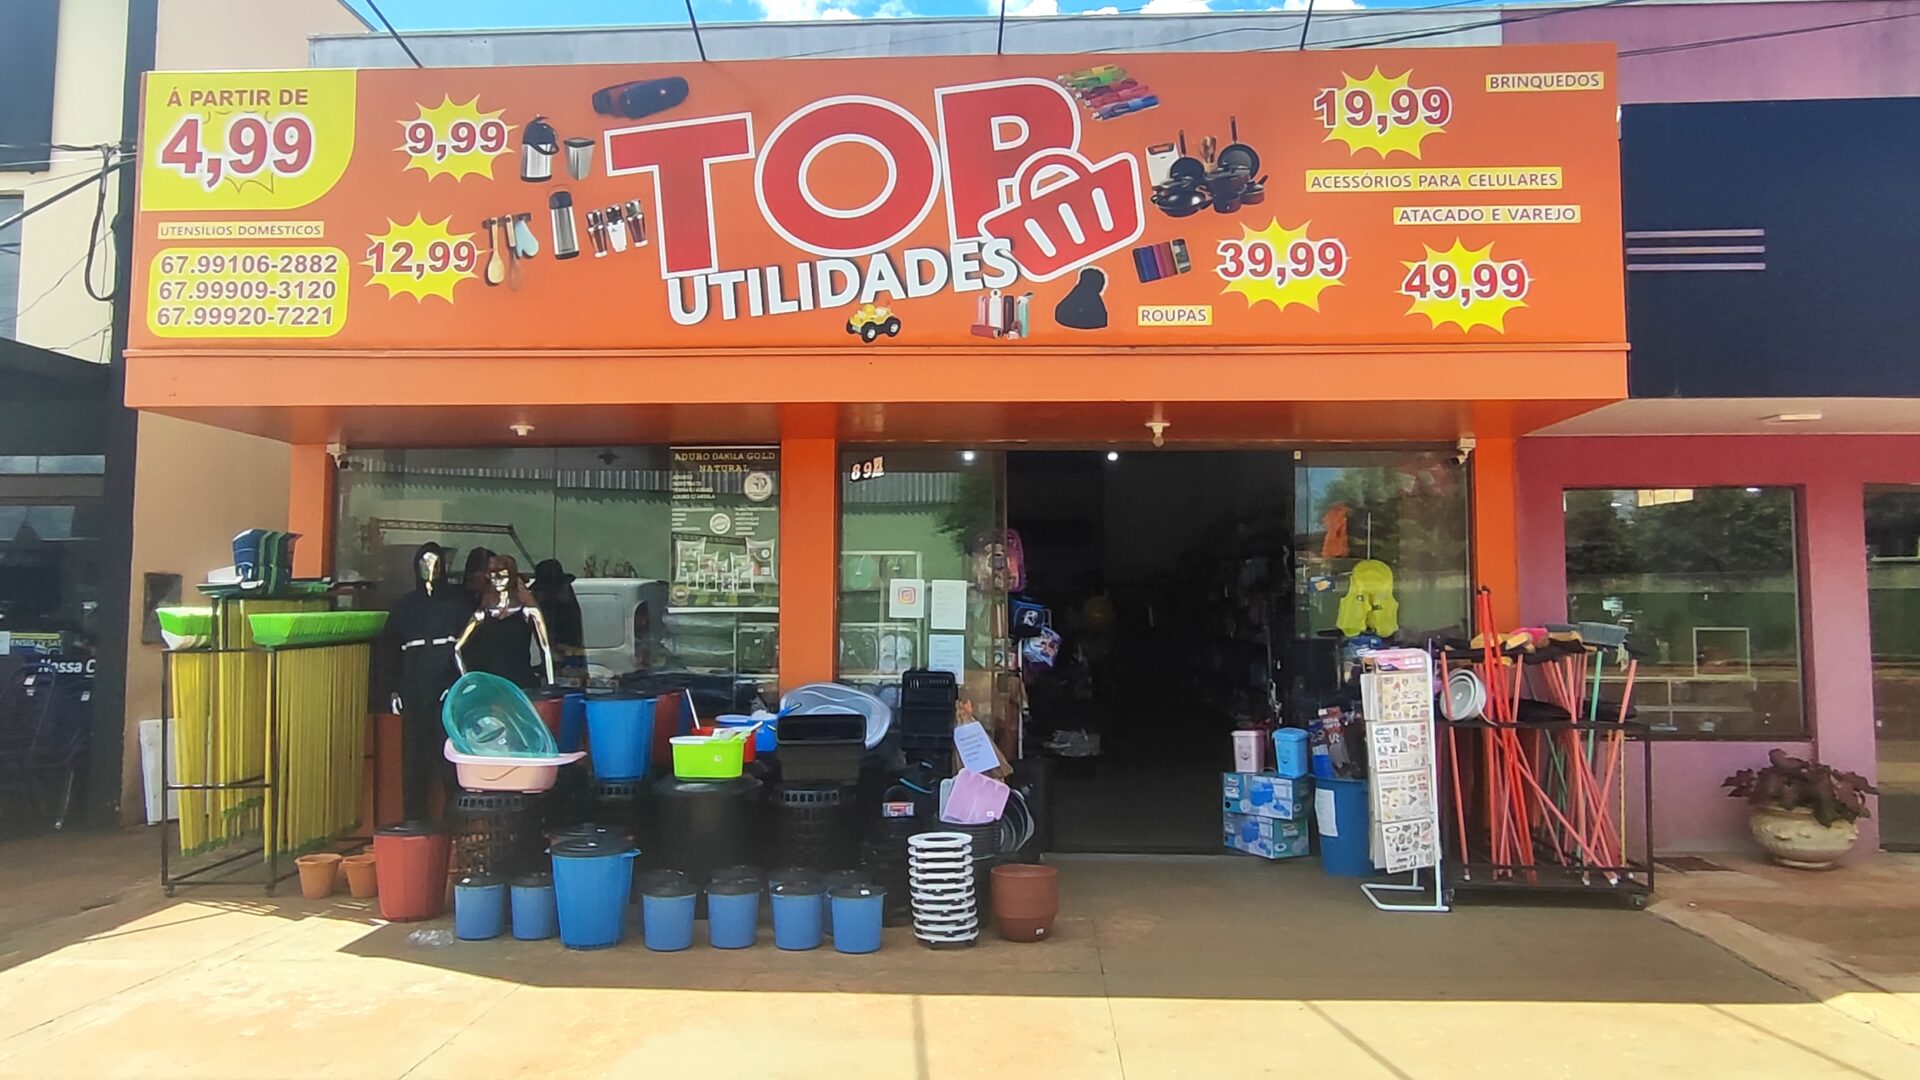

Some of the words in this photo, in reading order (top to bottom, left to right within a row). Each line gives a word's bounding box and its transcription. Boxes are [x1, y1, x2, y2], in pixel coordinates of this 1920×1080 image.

[1489, 74, 1599, 89] BRINQUEDOS
[167, 86, 182, 107] Á
[191, 89, 270, 107] PARTIR
[279, 88, 308, 106] DE
[1314, 86, 1452, 135] 19,99
[405, 120, 506, 161] 9,99
[161, 116, 313, 188] 4,99
[604, 77, 1082, 279] TOP
[1311, 171, 1411, 189] ACESSÓRIOS
[1418, 173, 1462, 187] PARA
[1467, 172, 1558, 187] CELULARES
[1399, 208, 1484, 222] ATACADO
[1492, 207, 1501, 221] E
[1507, 207, 1575, 221] VAREJO
[160, 255, 338, 275] 67.99106-2882
[366, 240, 477, 279] 12,99
[1217, 240, 1346, 286] 39,99
[159, 281, 336, 300] 67.99909-3120
[666, 239, 1019, 326] UTILIDADES
[1402, 261, 1529, 307] 49,99
[157, 306, 334, 326] 67.99920-7221
[1141, 308, 1207, 324] ROUPAS
[674, 453, 710, 461] ADUBO
[746, 452, 776, 460] GOLD
[699, 464, 750, 473] NATURAL
